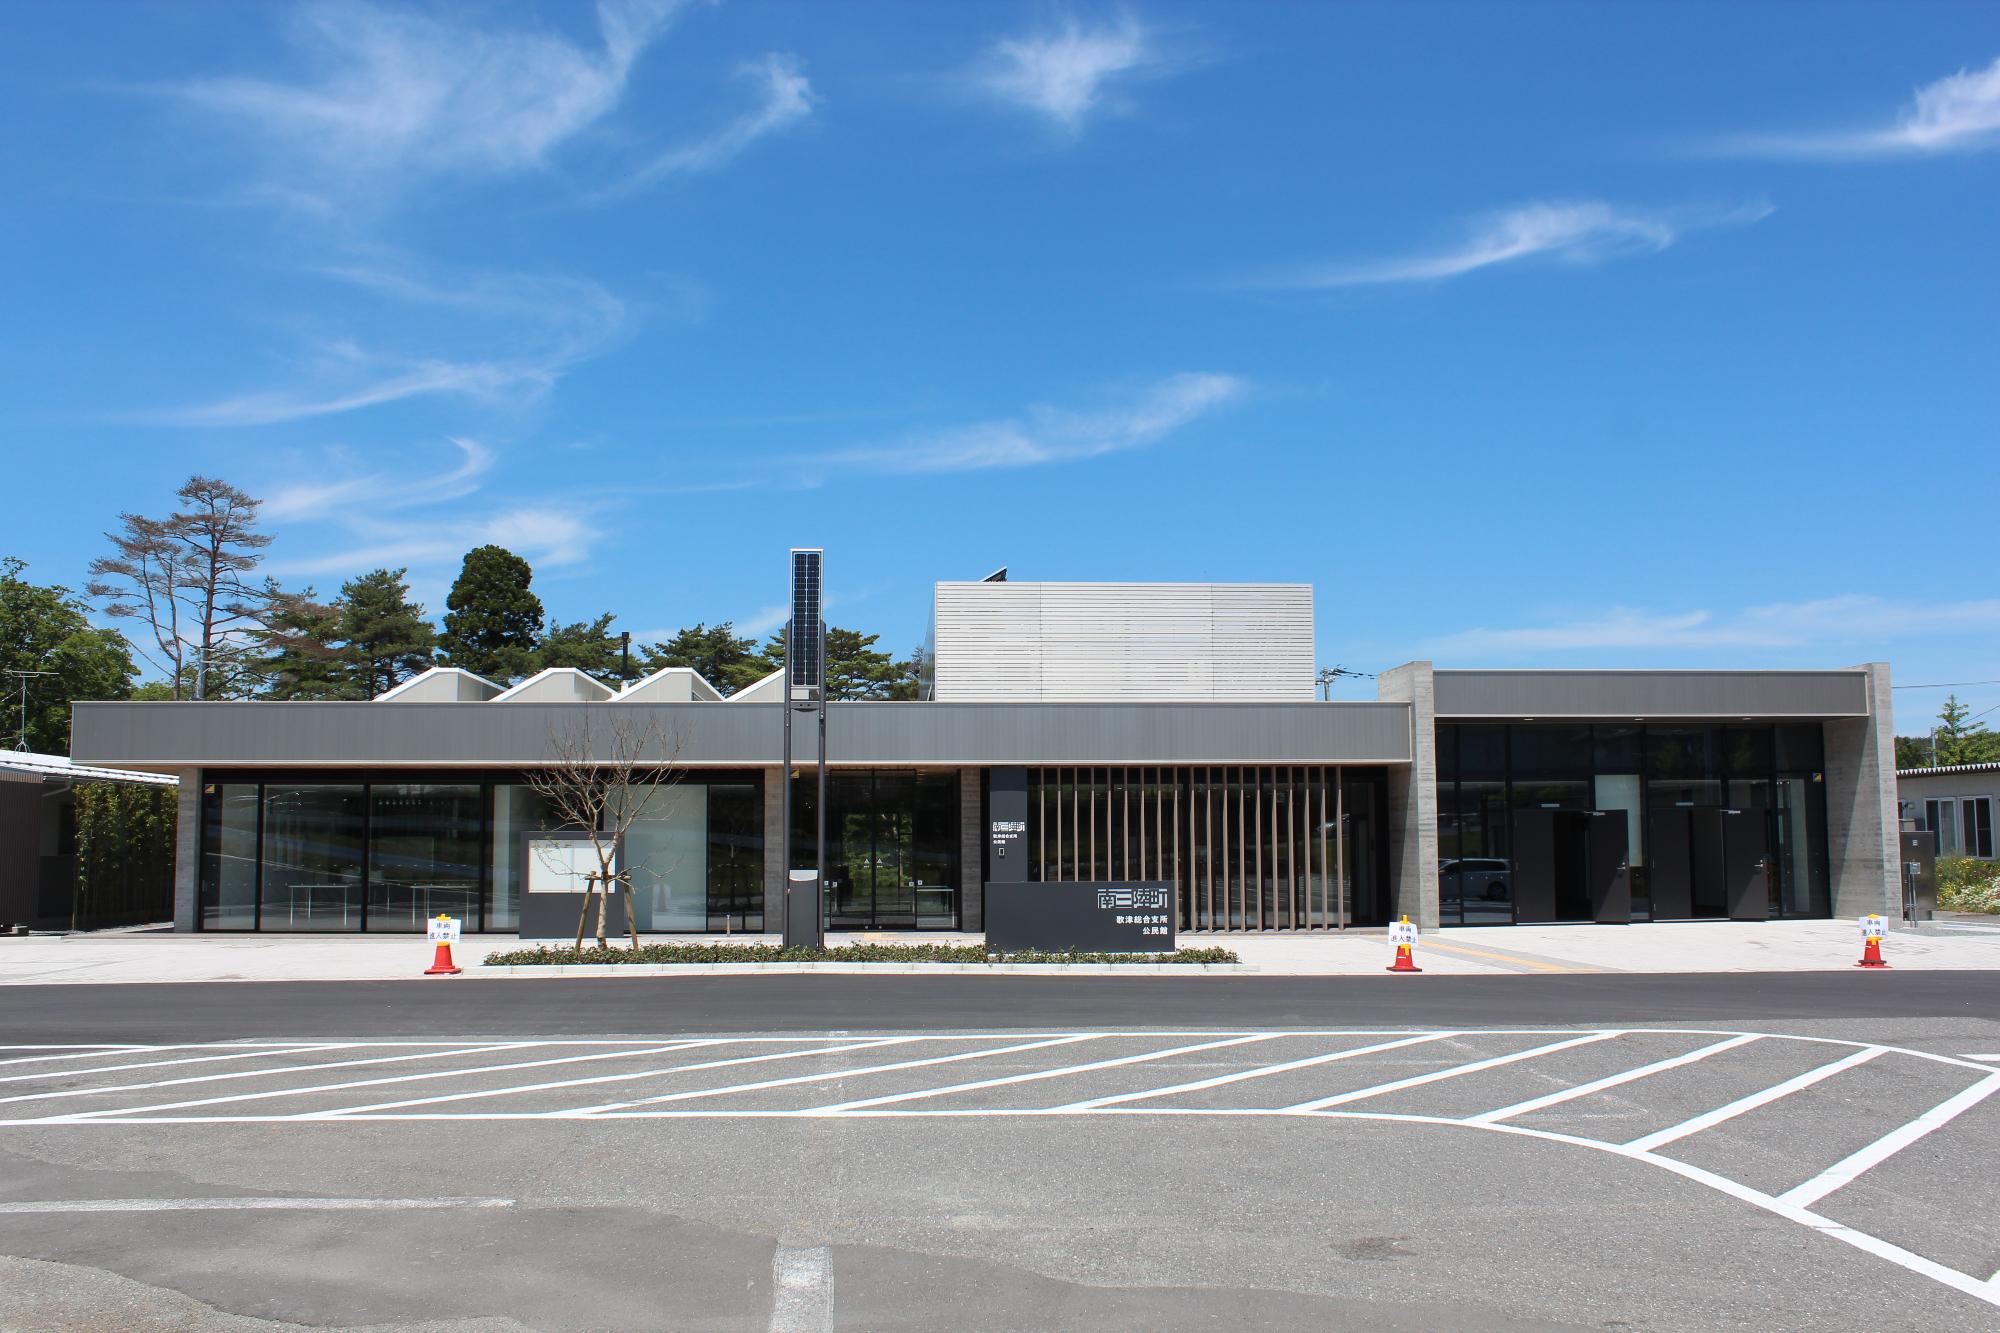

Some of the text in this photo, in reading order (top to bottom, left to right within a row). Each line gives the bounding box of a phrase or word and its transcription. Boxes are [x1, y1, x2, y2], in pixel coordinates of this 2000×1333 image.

[1097, 888, 1168, 909] 南三陸町
[1116, 915, 1168, 924] 歌津総合支所
[1142, 926, 1168, 935] 公民館
